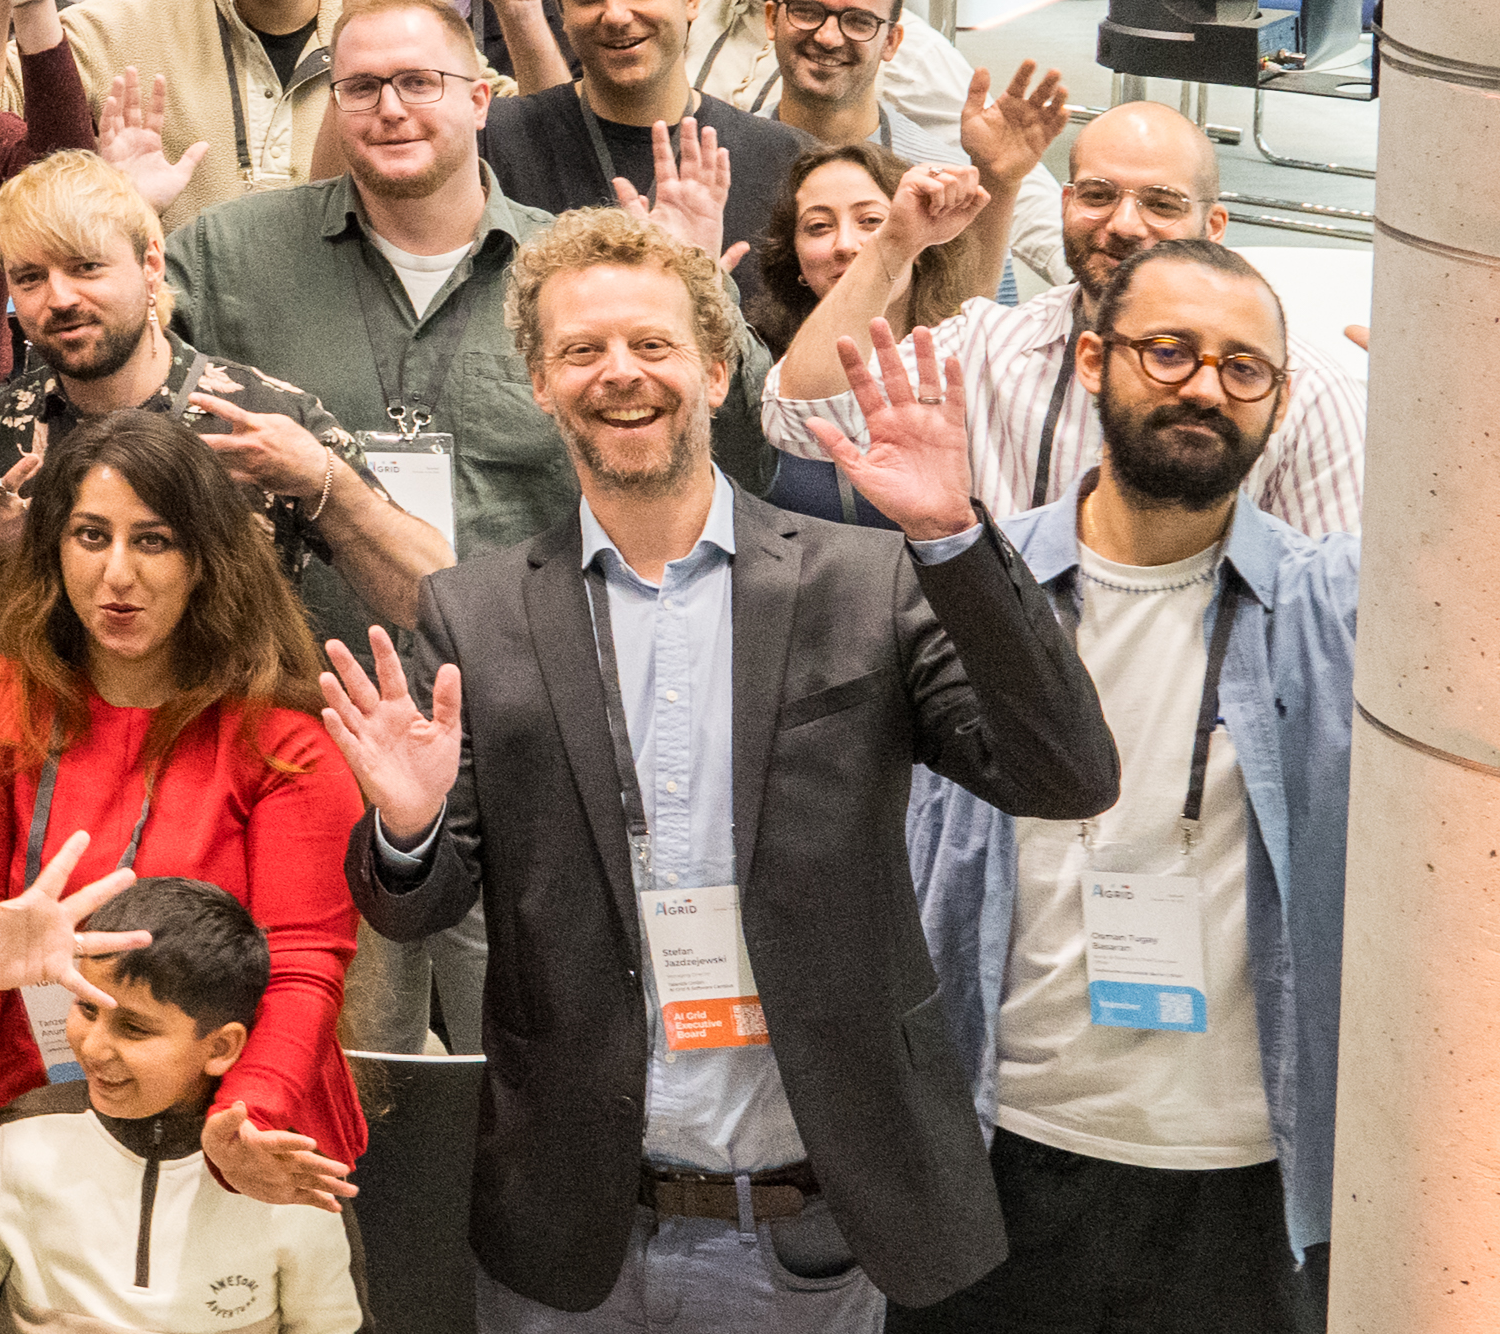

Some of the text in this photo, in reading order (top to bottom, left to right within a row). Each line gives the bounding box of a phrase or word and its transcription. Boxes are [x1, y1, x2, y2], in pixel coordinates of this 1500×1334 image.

[662, 947, 694, 957] Stefan
[665, 955, 727, 968] Jazdzejewski
[674, 1011, 707, 1021] AI Grid
[675, 1020, 723, 1030] Executive
[677, 1029, 707, 1039] Board
